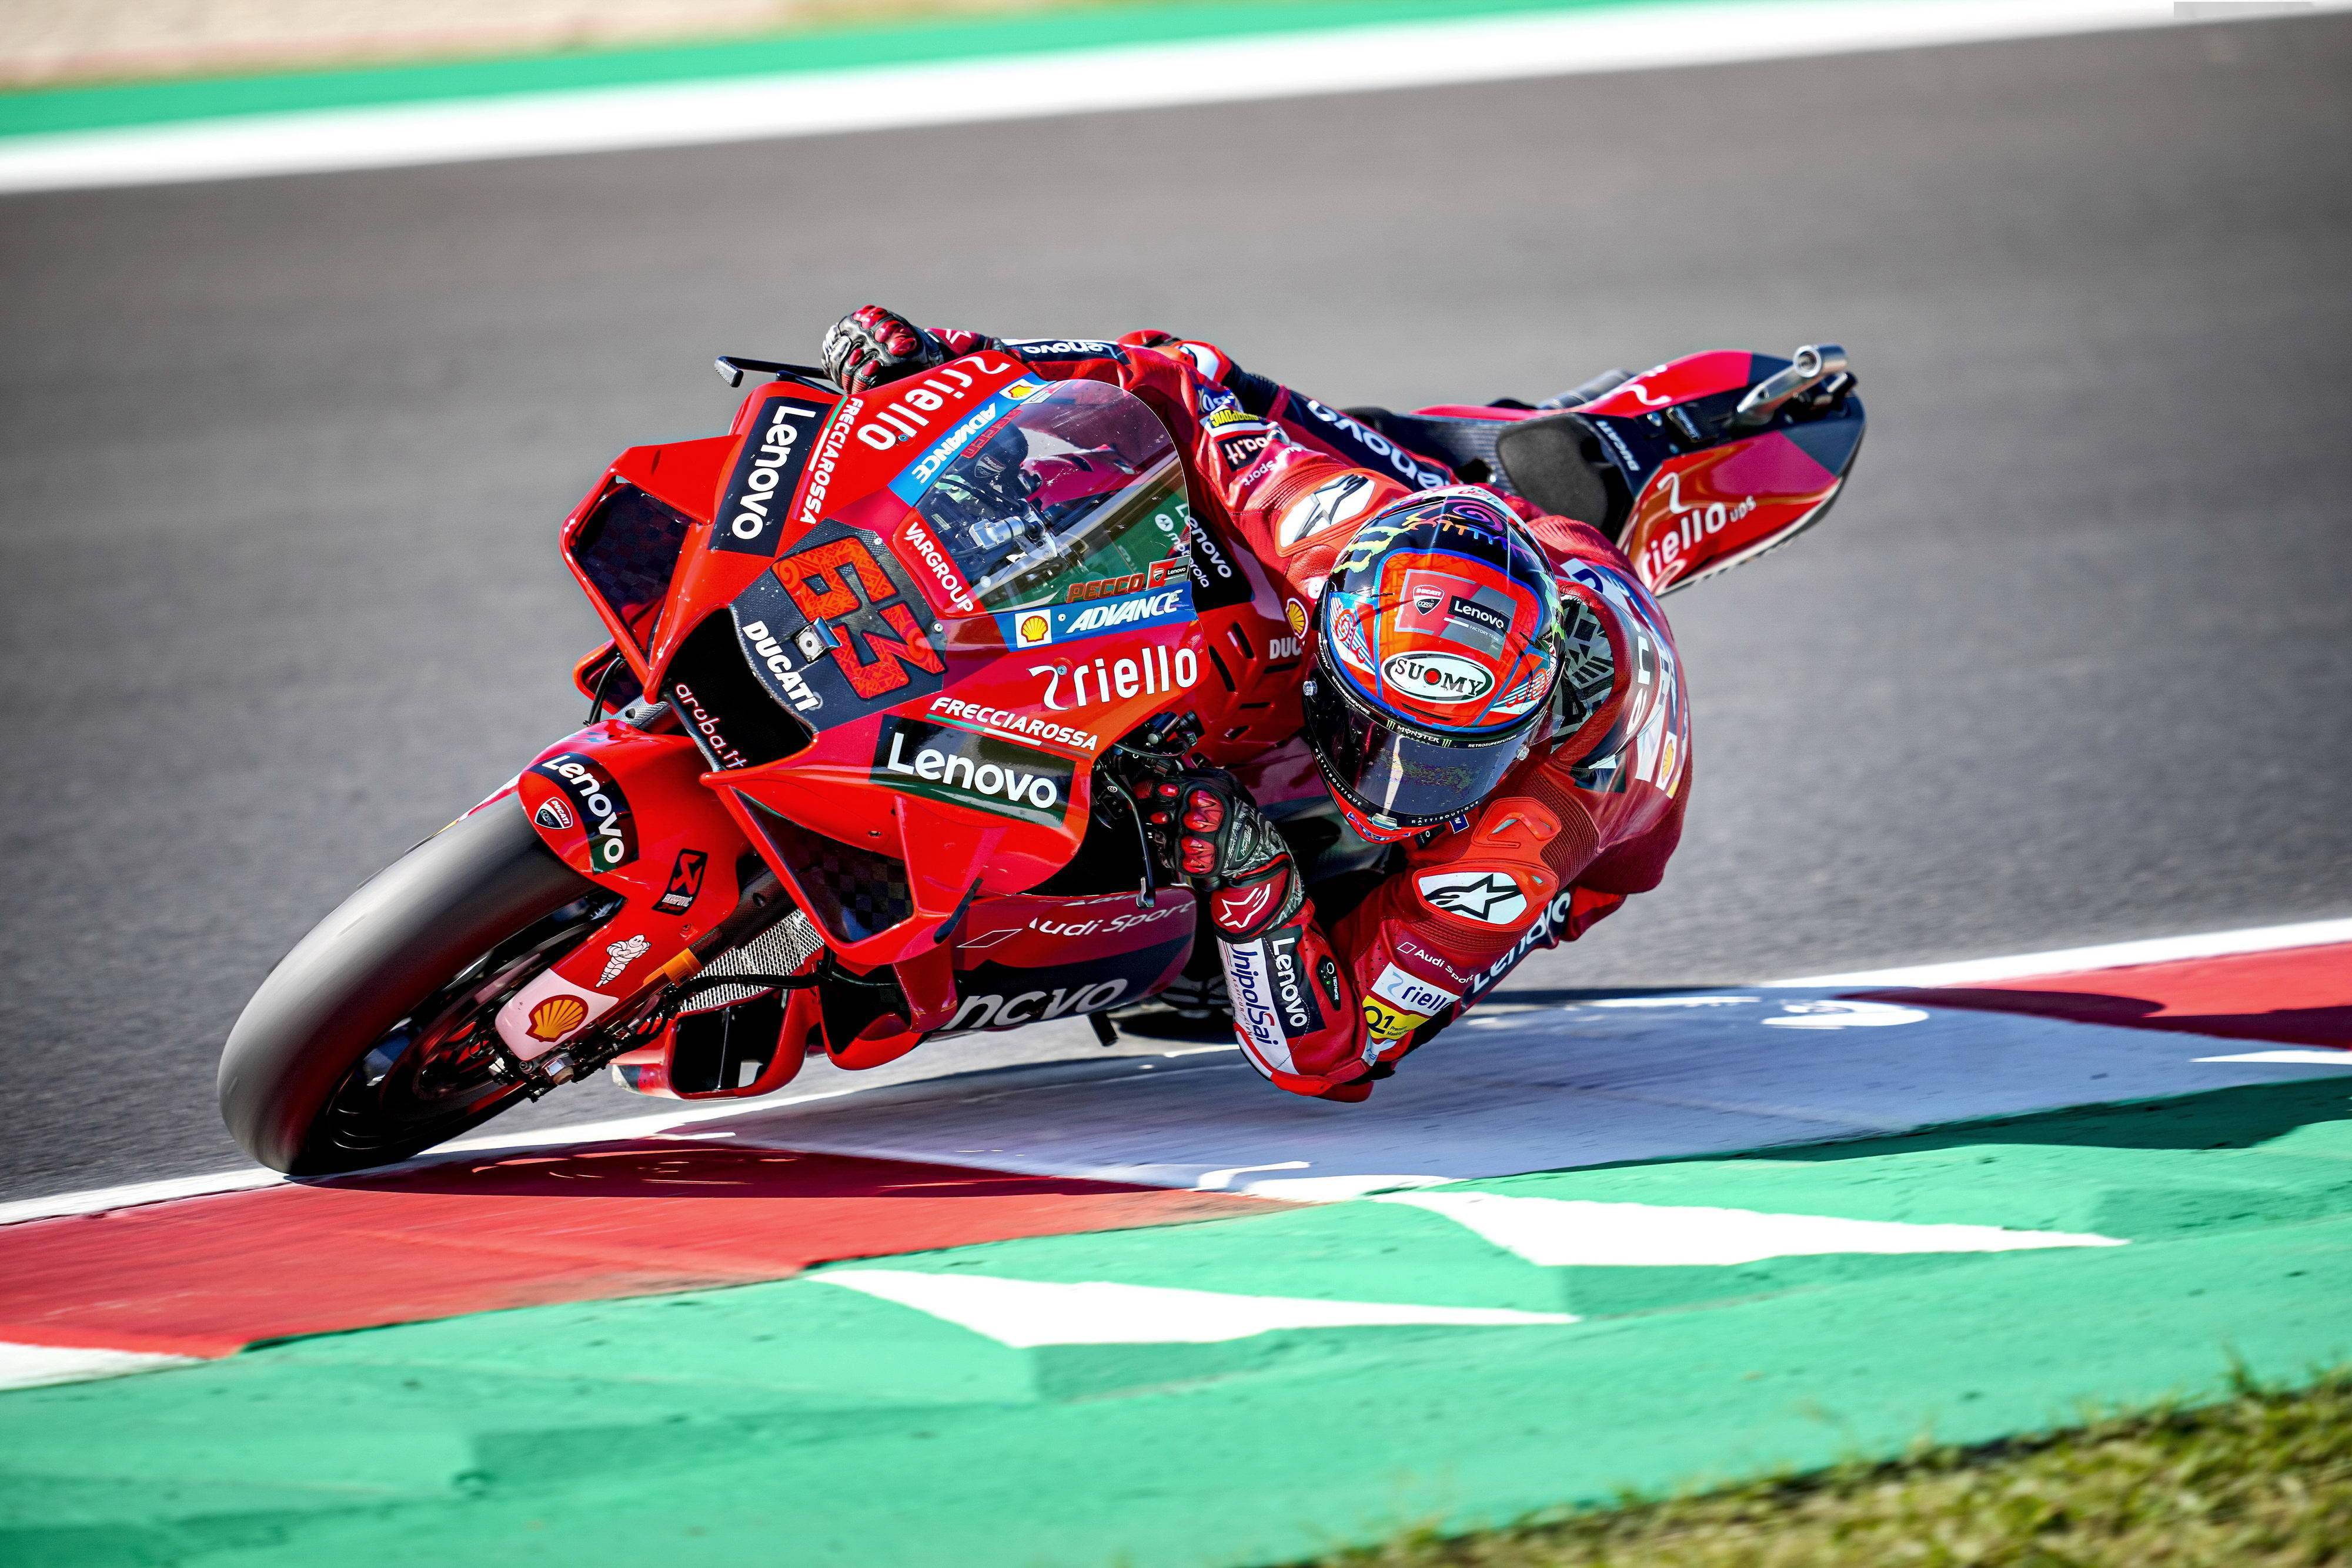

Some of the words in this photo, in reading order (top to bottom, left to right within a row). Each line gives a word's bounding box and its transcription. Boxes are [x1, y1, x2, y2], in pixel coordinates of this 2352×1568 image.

[858, 369, 973, 451] riello
[800, 397, 864, 524] FRECCIAROSSA
[912, 402, 997, 484] ADVANCE
[1307, 400, 1449, 490] enovo
[732, 406, 816, 540] Lenovo
[903, 521, 974, 613] VARGROUP
[1175, 503, 1232, 579] Lenovo
[1065, 573, 1146, 603] PECCO
[1167, 567, 1186, 576] Lenovo
[1415, 588, 1442, 597] DUCATI
[770, 535, 948, 700] 63
[1065, 589, 1184, 635] ADVANCE
[1454, 600, 1505, 629] Lenovo
[1469, 624, 1489, 637] FACTORY
[1488, 631, 1500, 643] TEAM
[742, 620, 819, 713] DUCATI
[1073, 644, 1198, 708] riello
[1269, 636, 1302, 660] DUC
[1394, 658, 1485, 698] SUOMY
[674, 683, 749, 770] aruba.it
[930, 697, 1099, 751] FRECCIAROSSA
[1396, 724, 1439, 744] MONSTER
[1468, 734, 1518, 748] RETROSUPERFUTURE
[887, 731, 1057, 809] Lenovo
[542, 755, 624, 864] Lenovo
[550, 800, 570, 824] DUCATI
[1101, 899, 1198, 933] Sport
[1272, 937, 1308, 1028] Lenovo
[1414, 949, 1445, 968] Audi
[1445, 964, 1474, 984] Sport
